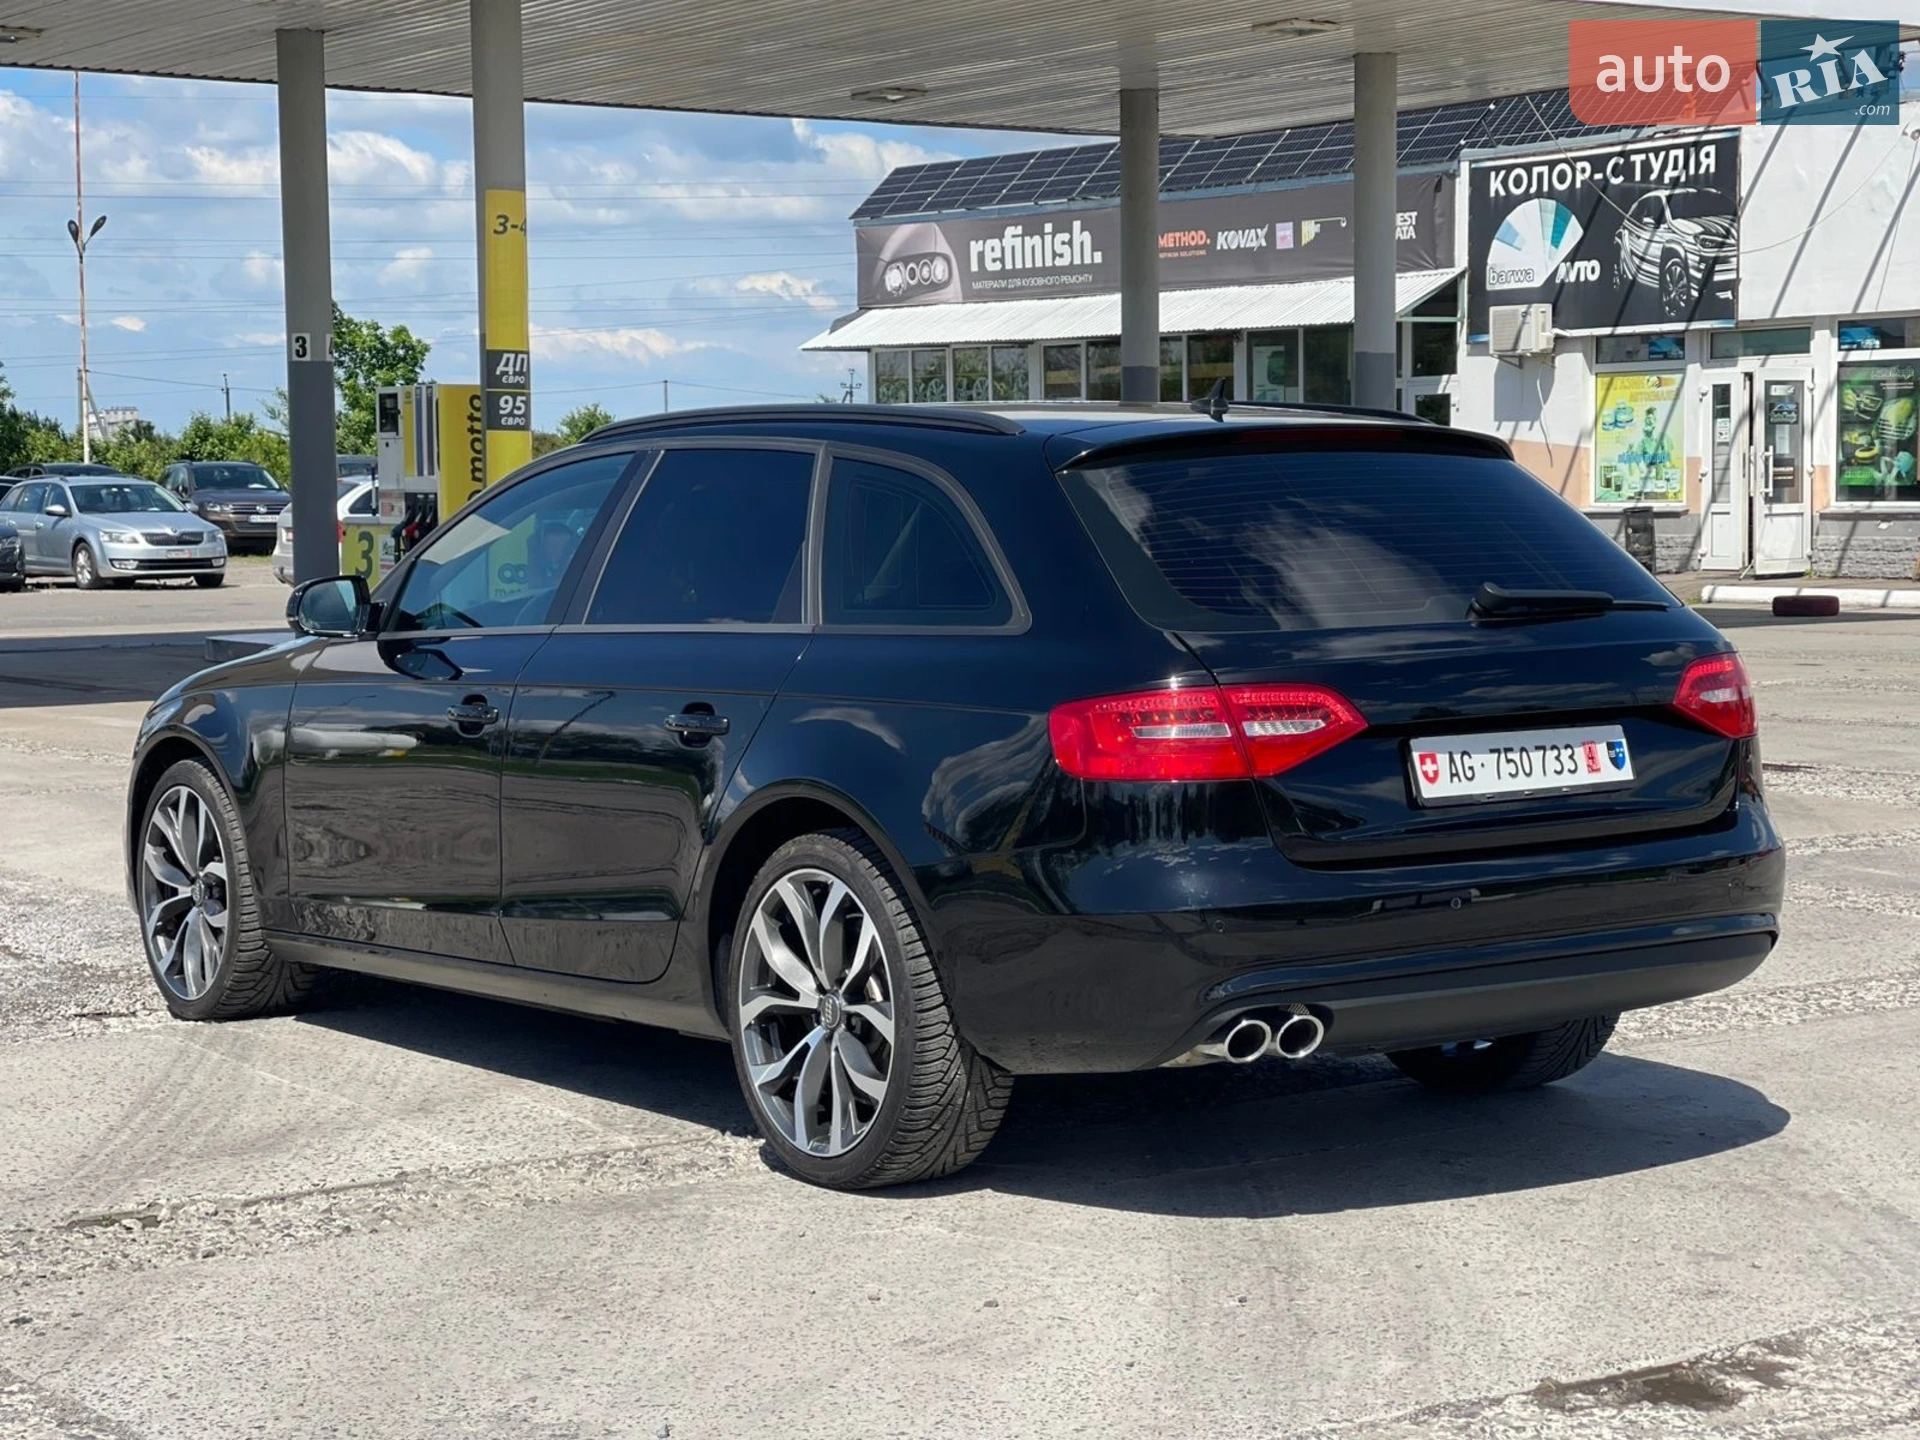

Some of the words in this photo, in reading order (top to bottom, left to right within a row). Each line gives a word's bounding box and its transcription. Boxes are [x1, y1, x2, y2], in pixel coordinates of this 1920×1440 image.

[1395, 211, 1418, 226] EST
[1216, 224, 1268, 251] KOVAX
[1395, 226, 1416, 240] ATA
[969, 220, 1102, 272] refinish.
[1489, 267, 1534, 284] barwa
[295, 336, 307, 358] 3
[496, 353, 528, 375] ДП
[499, 395, 527, 415] 95
[355, 531, 374, 580] 3
